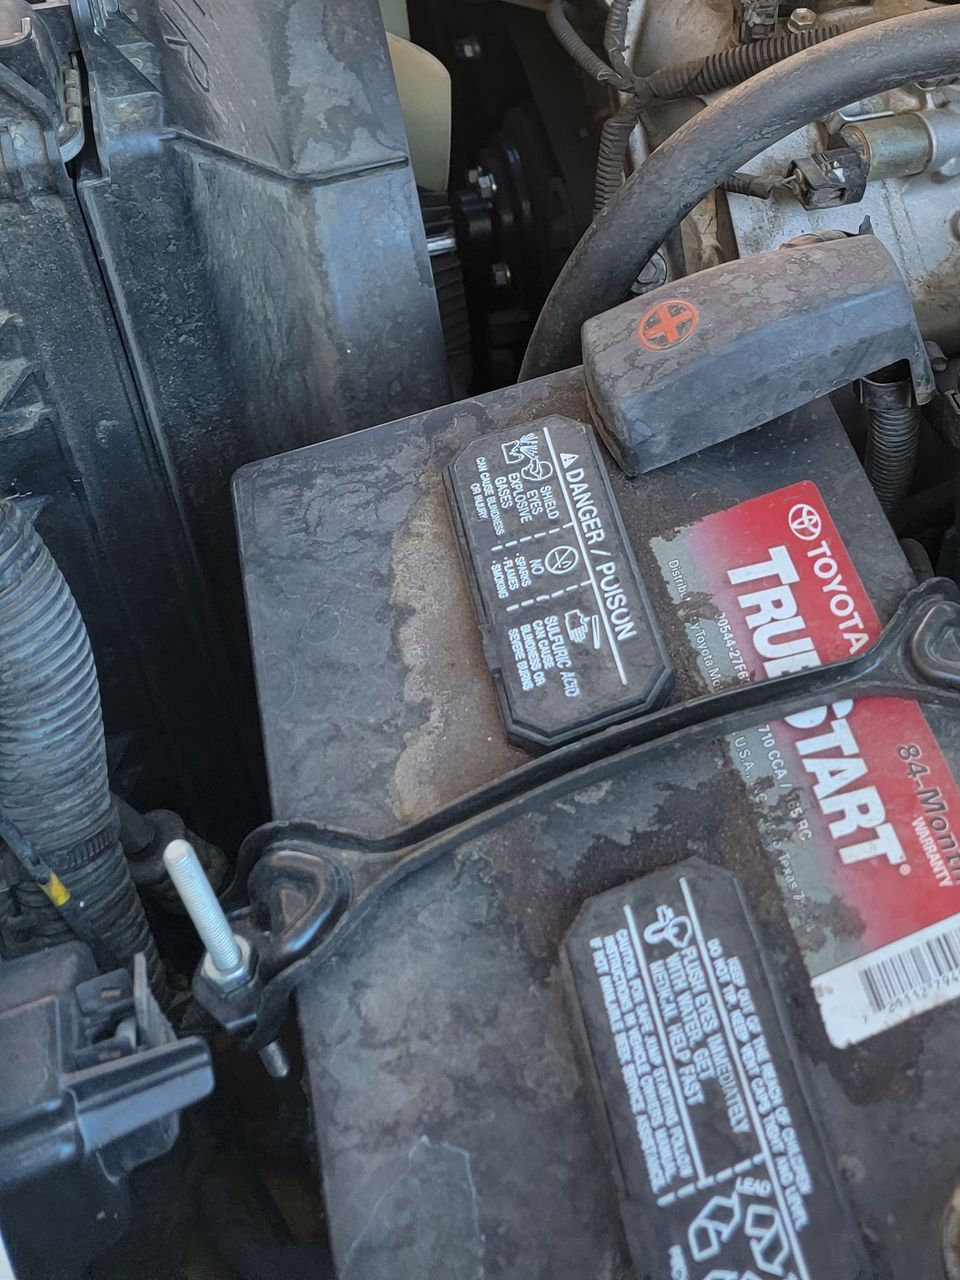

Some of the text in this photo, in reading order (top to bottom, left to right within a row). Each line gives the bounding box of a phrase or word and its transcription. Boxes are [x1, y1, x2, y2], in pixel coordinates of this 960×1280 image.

[469, 482, 488, 518] OR INJURY
[475, 456, 505, 535] CAN CAUSE BLINDNESS
[494, 476, 513, 508] GASES
[507, 472, 532, 523] EXPLOSIVE
[526, 489, 543, 515] EYES
[539, 485, 559, 519] SHIELD
[514, 555, 531, 587] SPARKS
[528, 558, 544, 575] NO
[565, 470, 604, 545] DANGER
[596, 561, 637, 641] POISON
[490, 563, 508, 598] SMOKING
[502, 559, 519, 590] FLAMES
[807, 540, 869, 654] TOYOTA
[508, 627, 533, 690] SEVERE BURNS
[520, 623, 546, 686] BLINDNESS OR
[532, 619, 554, 669] CAN CAUSE
[544, 615, 580, 697] SULFURIC ACID
[695, 629, 714, 667] Toyota
[768, 750, 788, 780] CCA
[910, 816, 953, 888] WARRANTY
[592, 949, 609, 973] NOT
[706, 937, 722, 957] DO
[713, 957, 730, 982] NOT
[599, 975, 624, 1031] AVAILABLE
[603, 935, 632, 1011] INSTRUCTIONS
[628, 1027, 650, 1074] VEHICLE
[628, 977, 645, 1003] FOR
[635, 1002, 653, 1033] SAFE
[649, 959, 703, 1103] MEDICAL HELP FAST
[665, 952, 687, 991] WITH
[693, 1047, 715, 1079] GET
[730, 1008, 749, 1042] KEEP
[644, 1035, 662, 1065] JUMP
[681, 945, 749, 1132] FLUSH EYES IMMEDIATELY
[736, 987, 755, 1013] OUT
[752, 1034, 770, 1062] THE
[761, 1062, 782, 1105] REACH
[774, 1105, 791, 1125] OF
[740, 1042, 760, 1075] VENT
[622, 1063, 644, 1112] SERVICE
[652, 1066, 678, 1125] STARTING
[750, 1077, 771, 1113] CAPS
[763, 1112, 784, 1151] TIGHT
[735, 1176, 773, 1198] LEAD
[775, 1155, 793, 1186] AND
